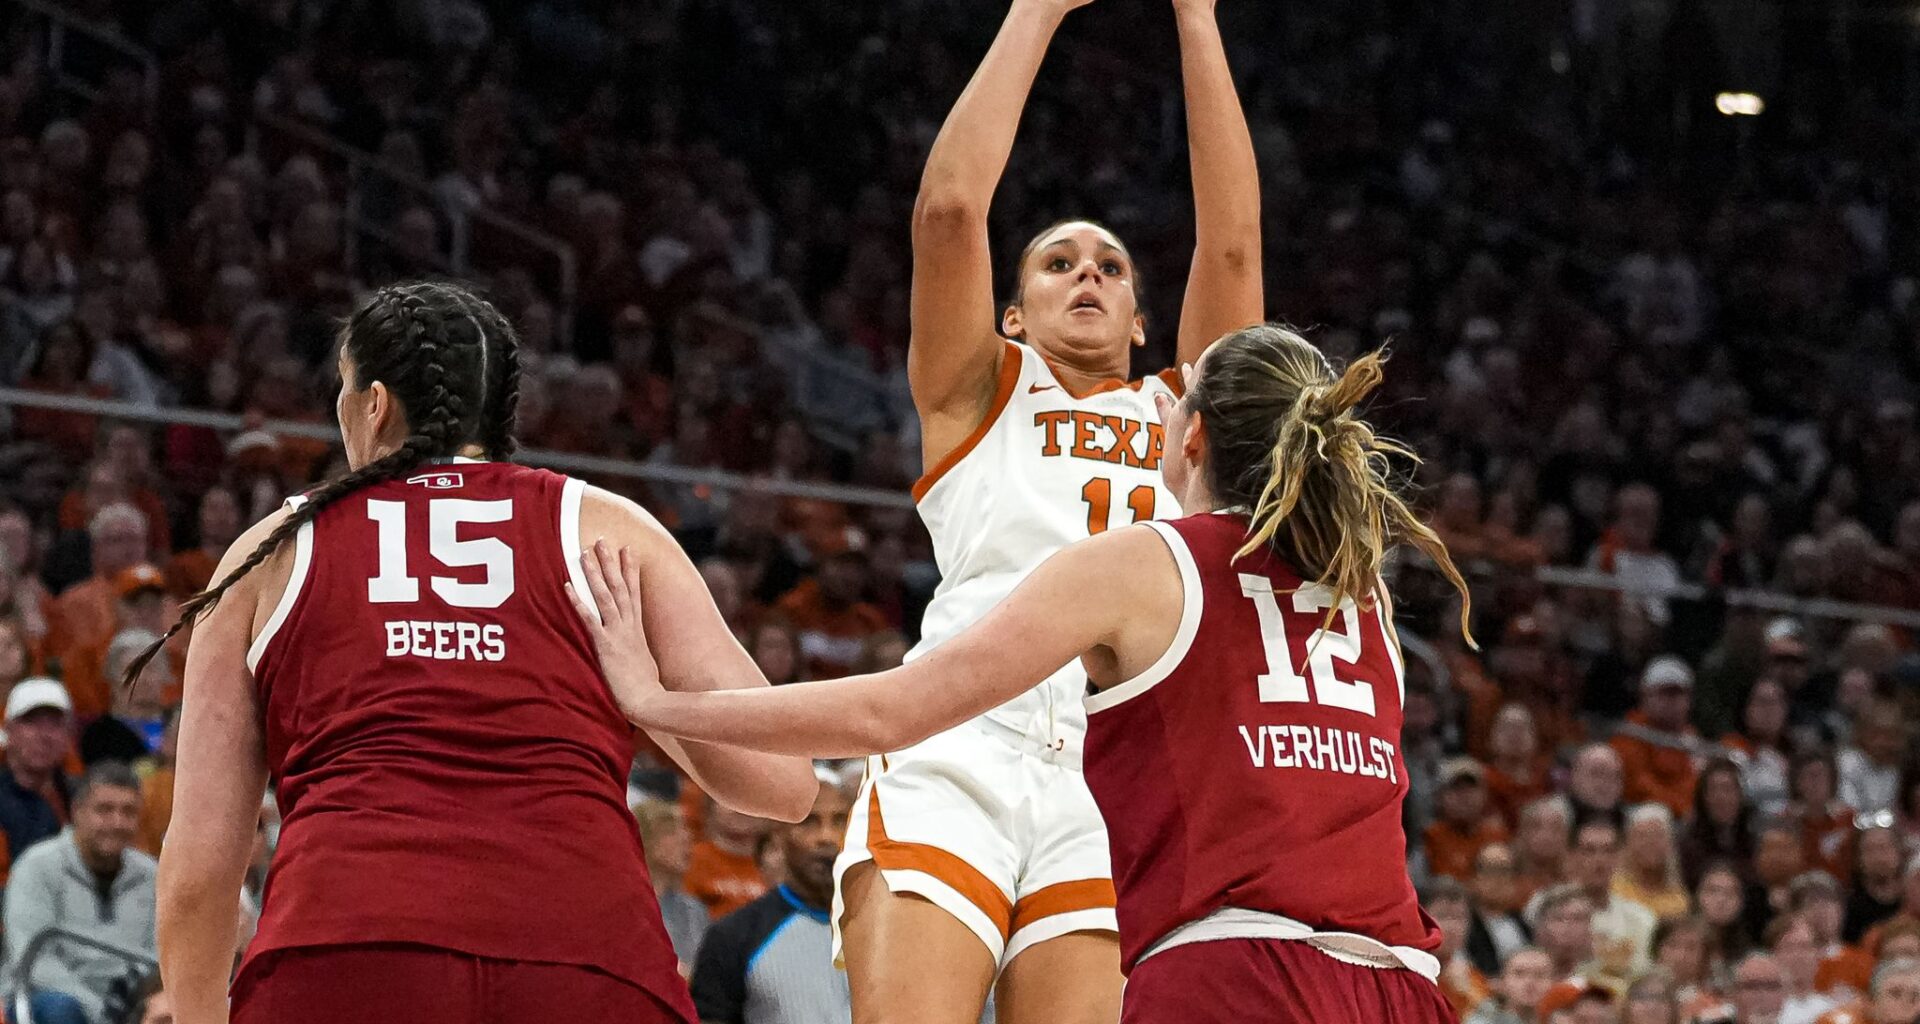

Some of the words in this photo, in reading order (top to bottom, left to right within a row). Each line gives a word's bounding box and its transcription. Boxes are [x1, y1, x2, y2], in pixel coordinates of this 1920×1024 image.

[1034, 410, 1164, 470] TEXA
[1081, 477, 1155, 536] 11
[367, 498, 515, 609] 15
[384, 620, 505, 661] BEERS
[1238, 573, 1376, 717] 12
[1238, 725, 1397, 784] VERHULST
